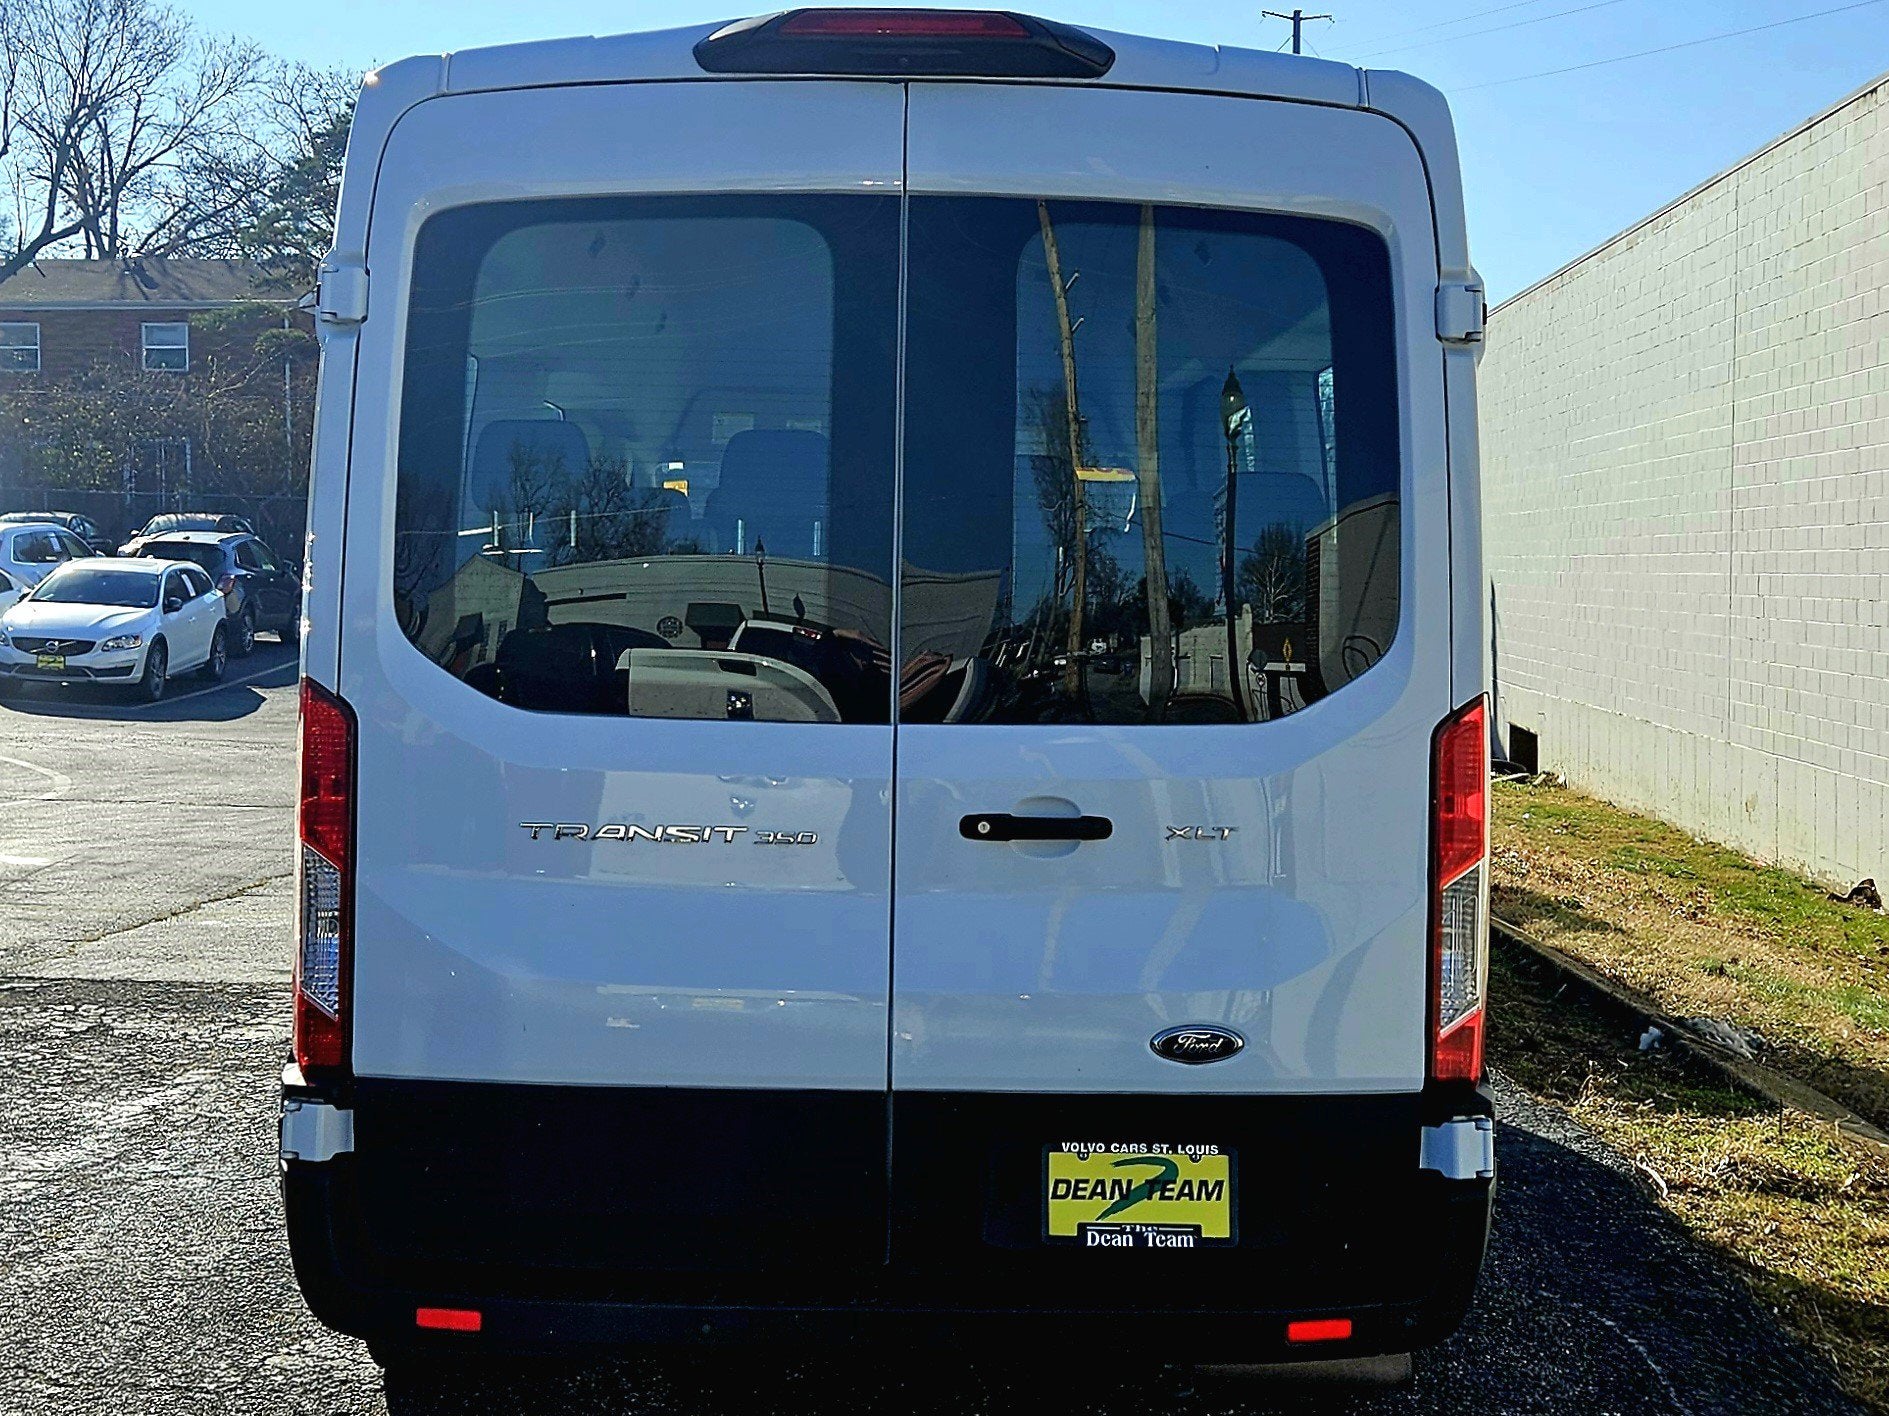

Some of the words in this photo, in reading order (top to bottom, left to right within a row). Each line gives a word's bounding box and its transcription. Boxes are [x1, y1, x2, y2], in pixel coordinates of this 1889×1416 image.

[519, 821, 749, 843] TRANSIT
[753, 830, 818, 845] 350
[1164, 826, 1239, 841] XLT
[1173, 1033, 1224, 1053] Ford
[1061, 1142, 1106, 1153] VOLVO
[1110, 1143, 1148, 1154] CARS
[1152, 1144, 1173, 1155] ST.
[1177, 1144, 1219, 1155] LOUIS
[1050, 1178, 1134, 1201] DEAN
[1145, 1179, 1225, 1202] TEAM
[1086, 1231, 1134, 1247] Dean
[1143, 1231, 1194, 1248] Team
